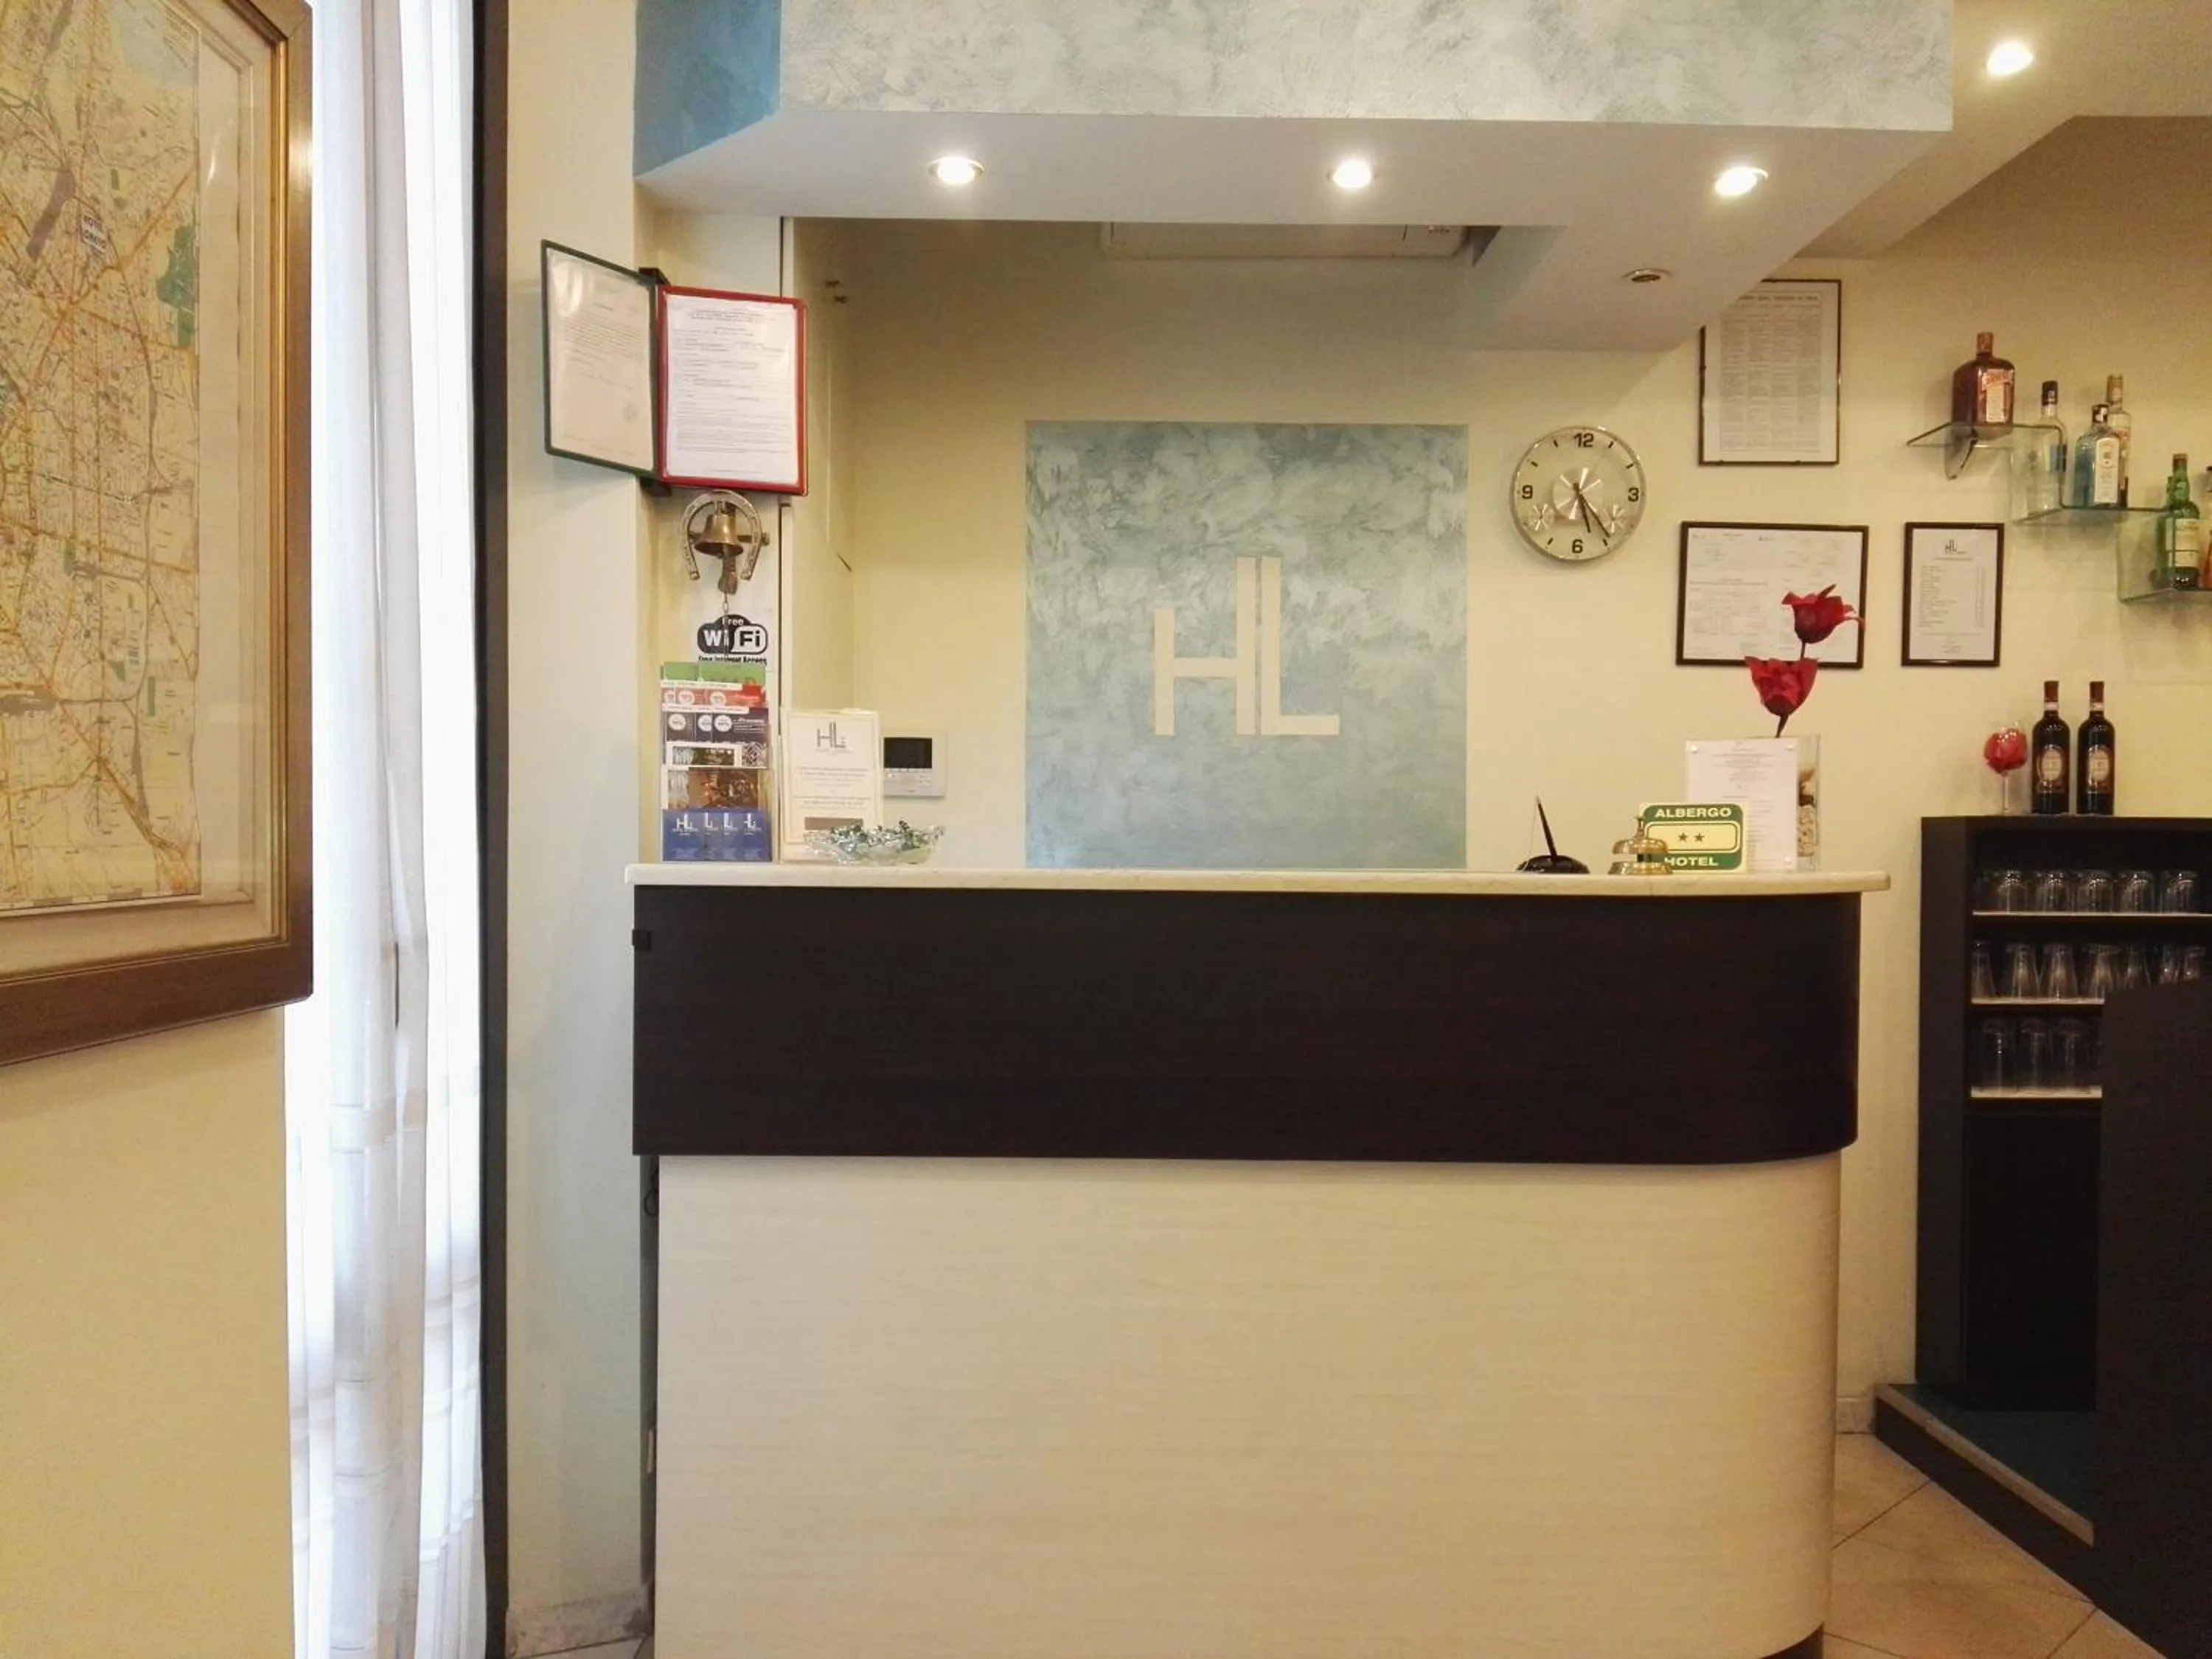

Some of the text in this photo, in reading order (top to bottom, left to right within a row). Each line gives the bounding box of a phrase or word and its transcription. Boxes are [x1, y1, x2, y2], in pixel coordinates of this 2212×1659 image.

[1573, 433, 1593, 448] 12
[1522, 485, 1533, 499] 9
[1628, 487, 1639, 501] 3
[1572, 539, 1583, 553] 6
[1153, 556, 1340, 736] HL
[1655, 807, 1732, 818] ALBERGO
[1664, 856, 1719, 866] HOTEL
